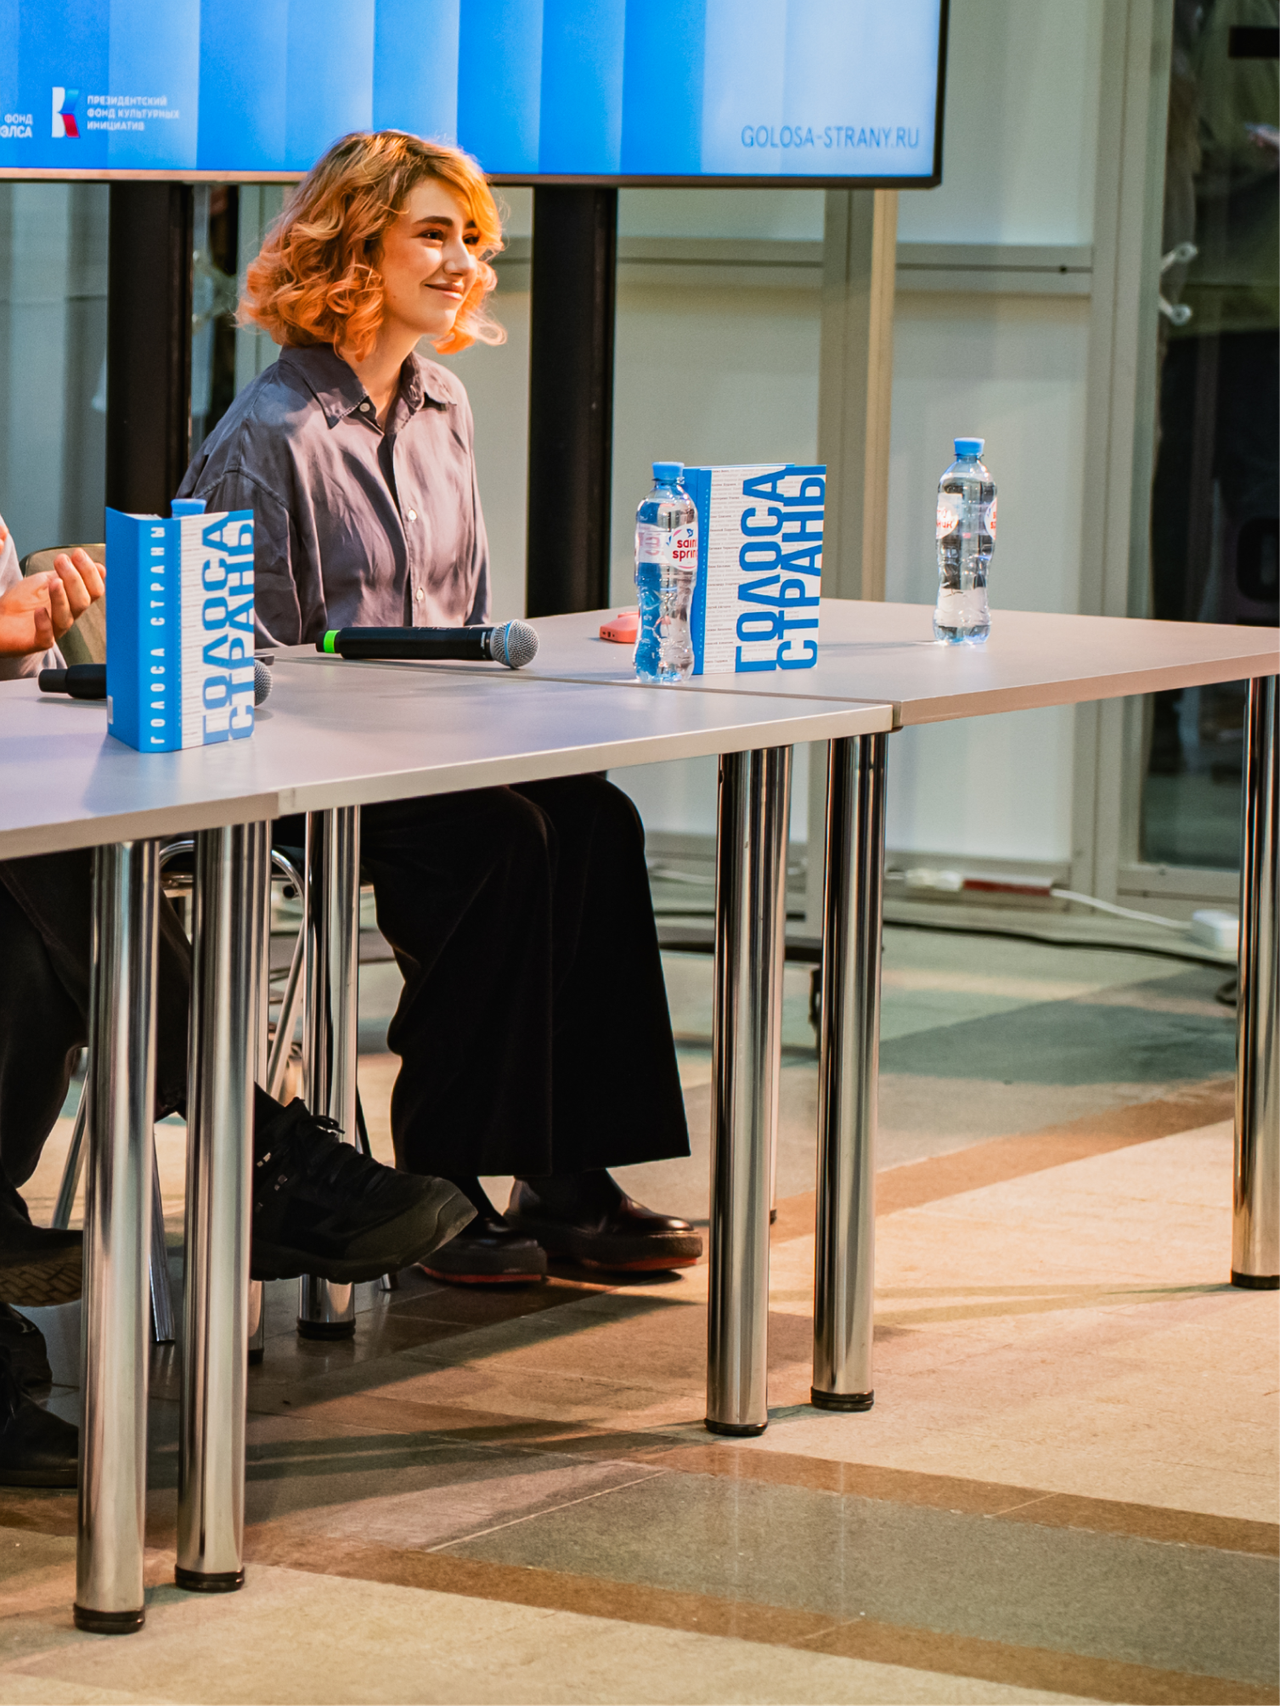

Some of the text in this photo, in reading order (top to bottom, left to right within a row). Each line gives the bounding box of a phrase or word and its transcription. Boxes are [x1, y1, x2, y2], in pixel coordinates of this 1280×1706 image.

[87, 95, 168, 107] ПРЕЗИДЕНТСКИЙ
[4, 113, 33, 125] ФОНД
[87, 108, 180, 119] ФОНД КУЛЬТУРНЫХ
[87, 121, 145, 132] ИНИЦИАТИВ
[741, 125, 919, 149] GOLOSA-STRANY.RU
[672, 550, 697, 562] sprin
[776, 464, 827, 671] СТРАНЫ
[735, 466, 785, 673] ГОЛОСА
[150, 526, 166, 744] ГОЛОСА СТРАНЫ
[202, 511, 230, 745] ГОЛОСА
[227, 509, 255, 741] СТРАНЫ
